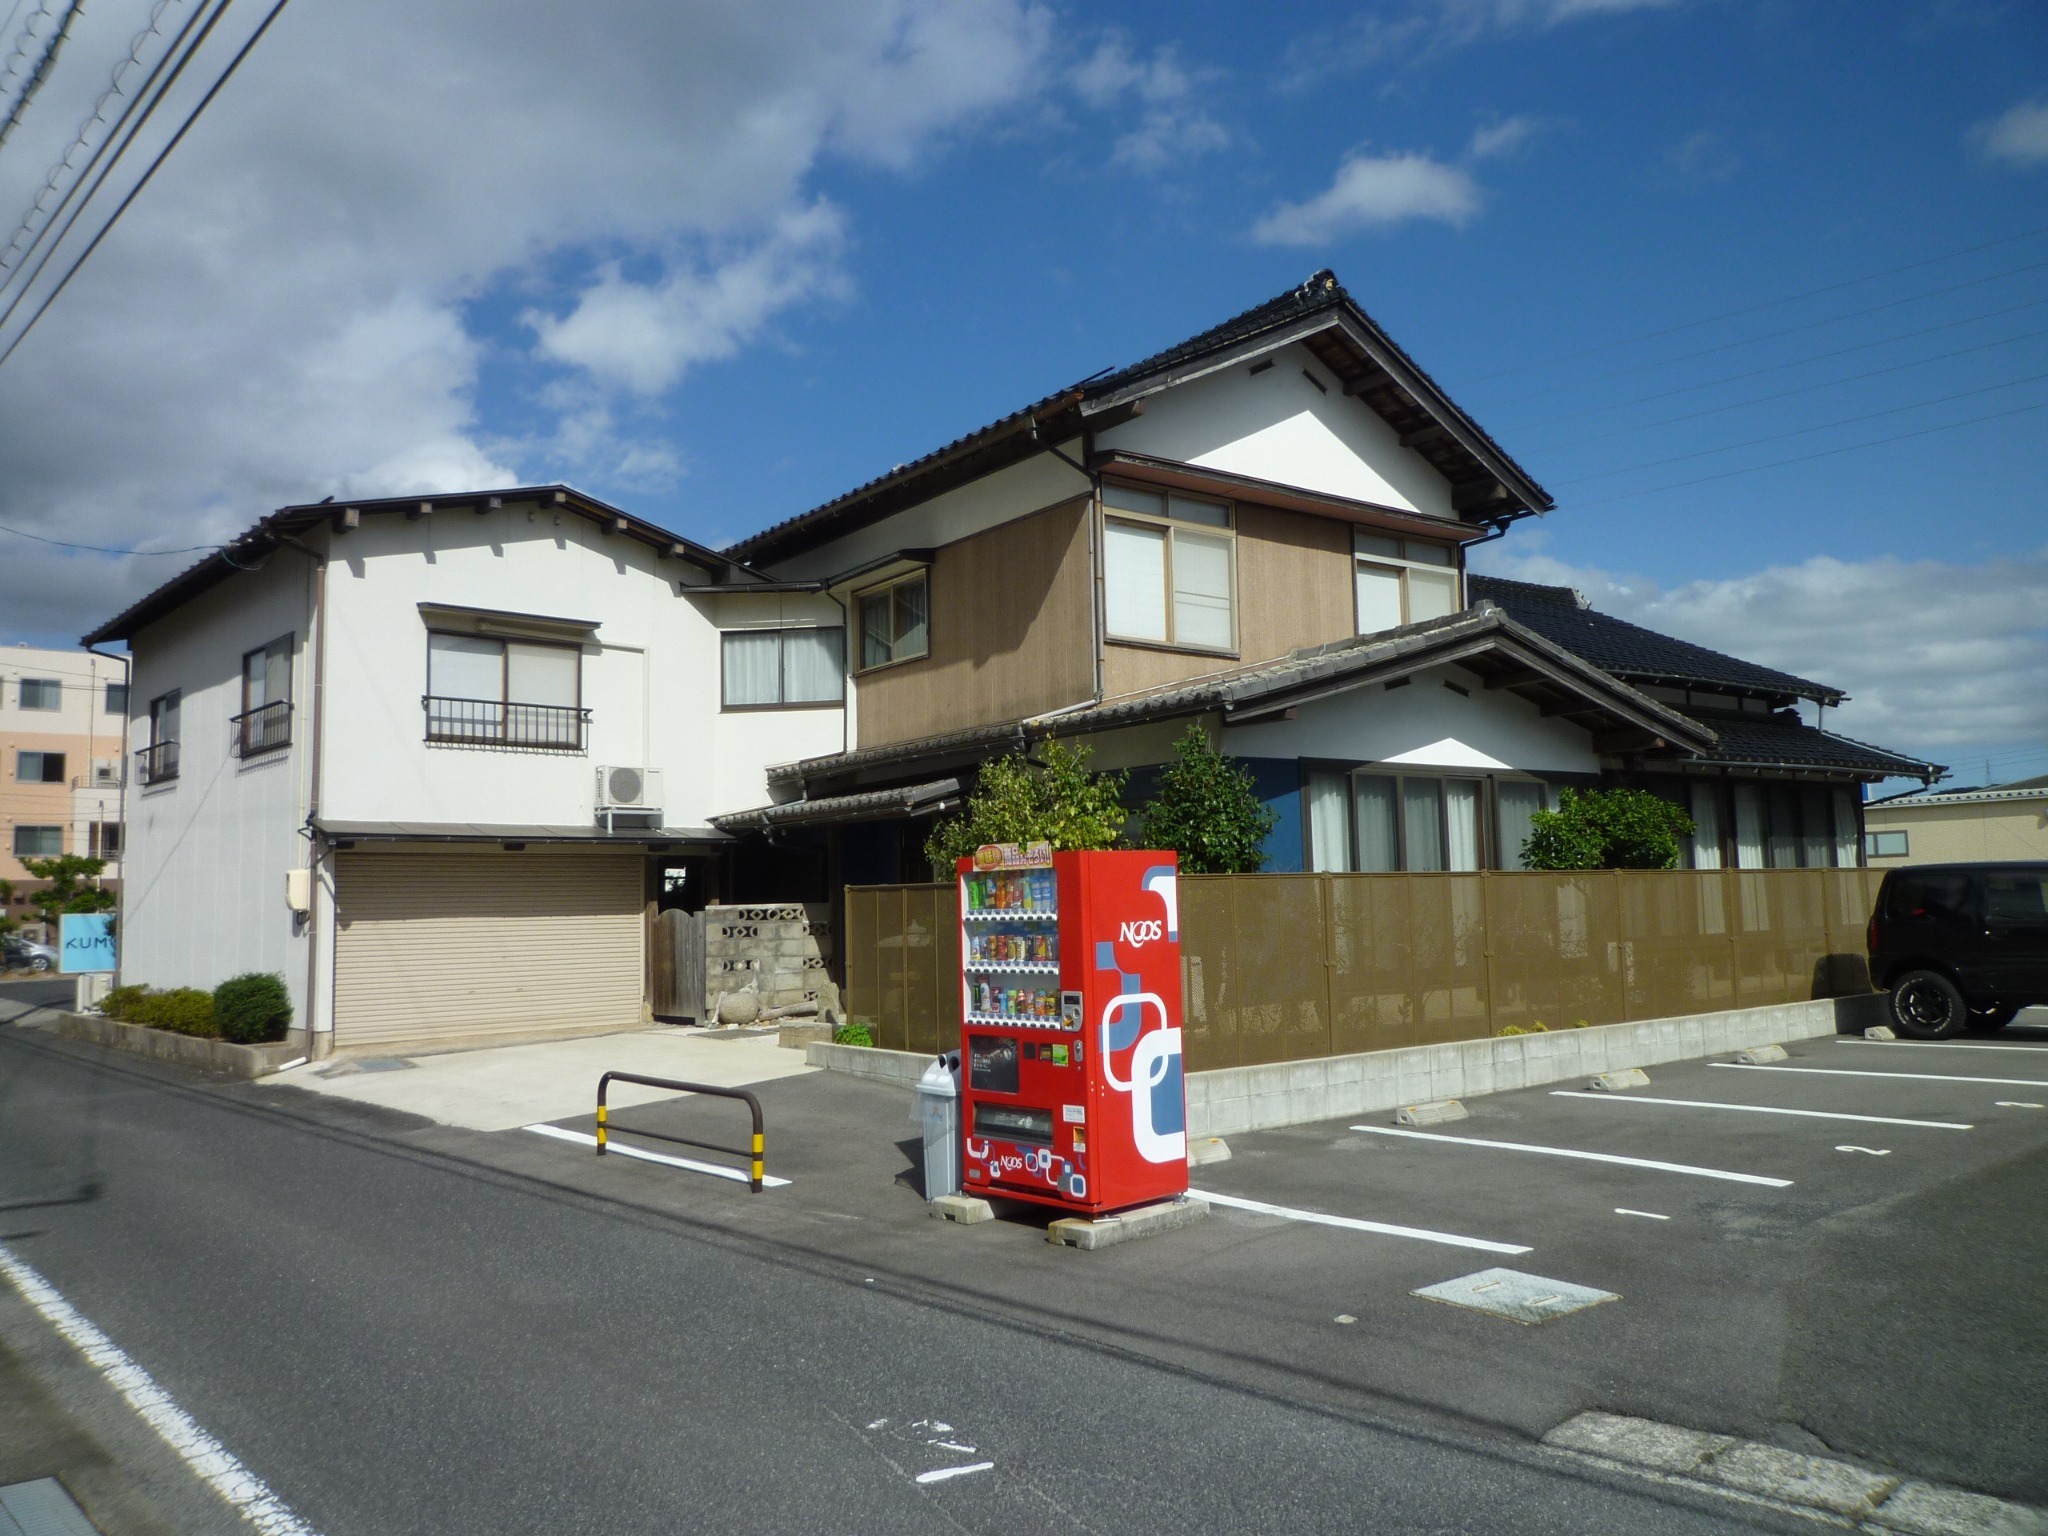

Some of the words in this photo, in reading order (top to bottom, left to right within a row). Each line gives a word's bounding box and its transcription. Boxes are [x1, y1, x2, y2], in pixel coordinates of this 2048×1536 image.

[1119, 920, 1162, 948] NOOS
[1834, 1145, 1892, 1155] 2
[1000, 1155, 1022, 1171] NOOS
